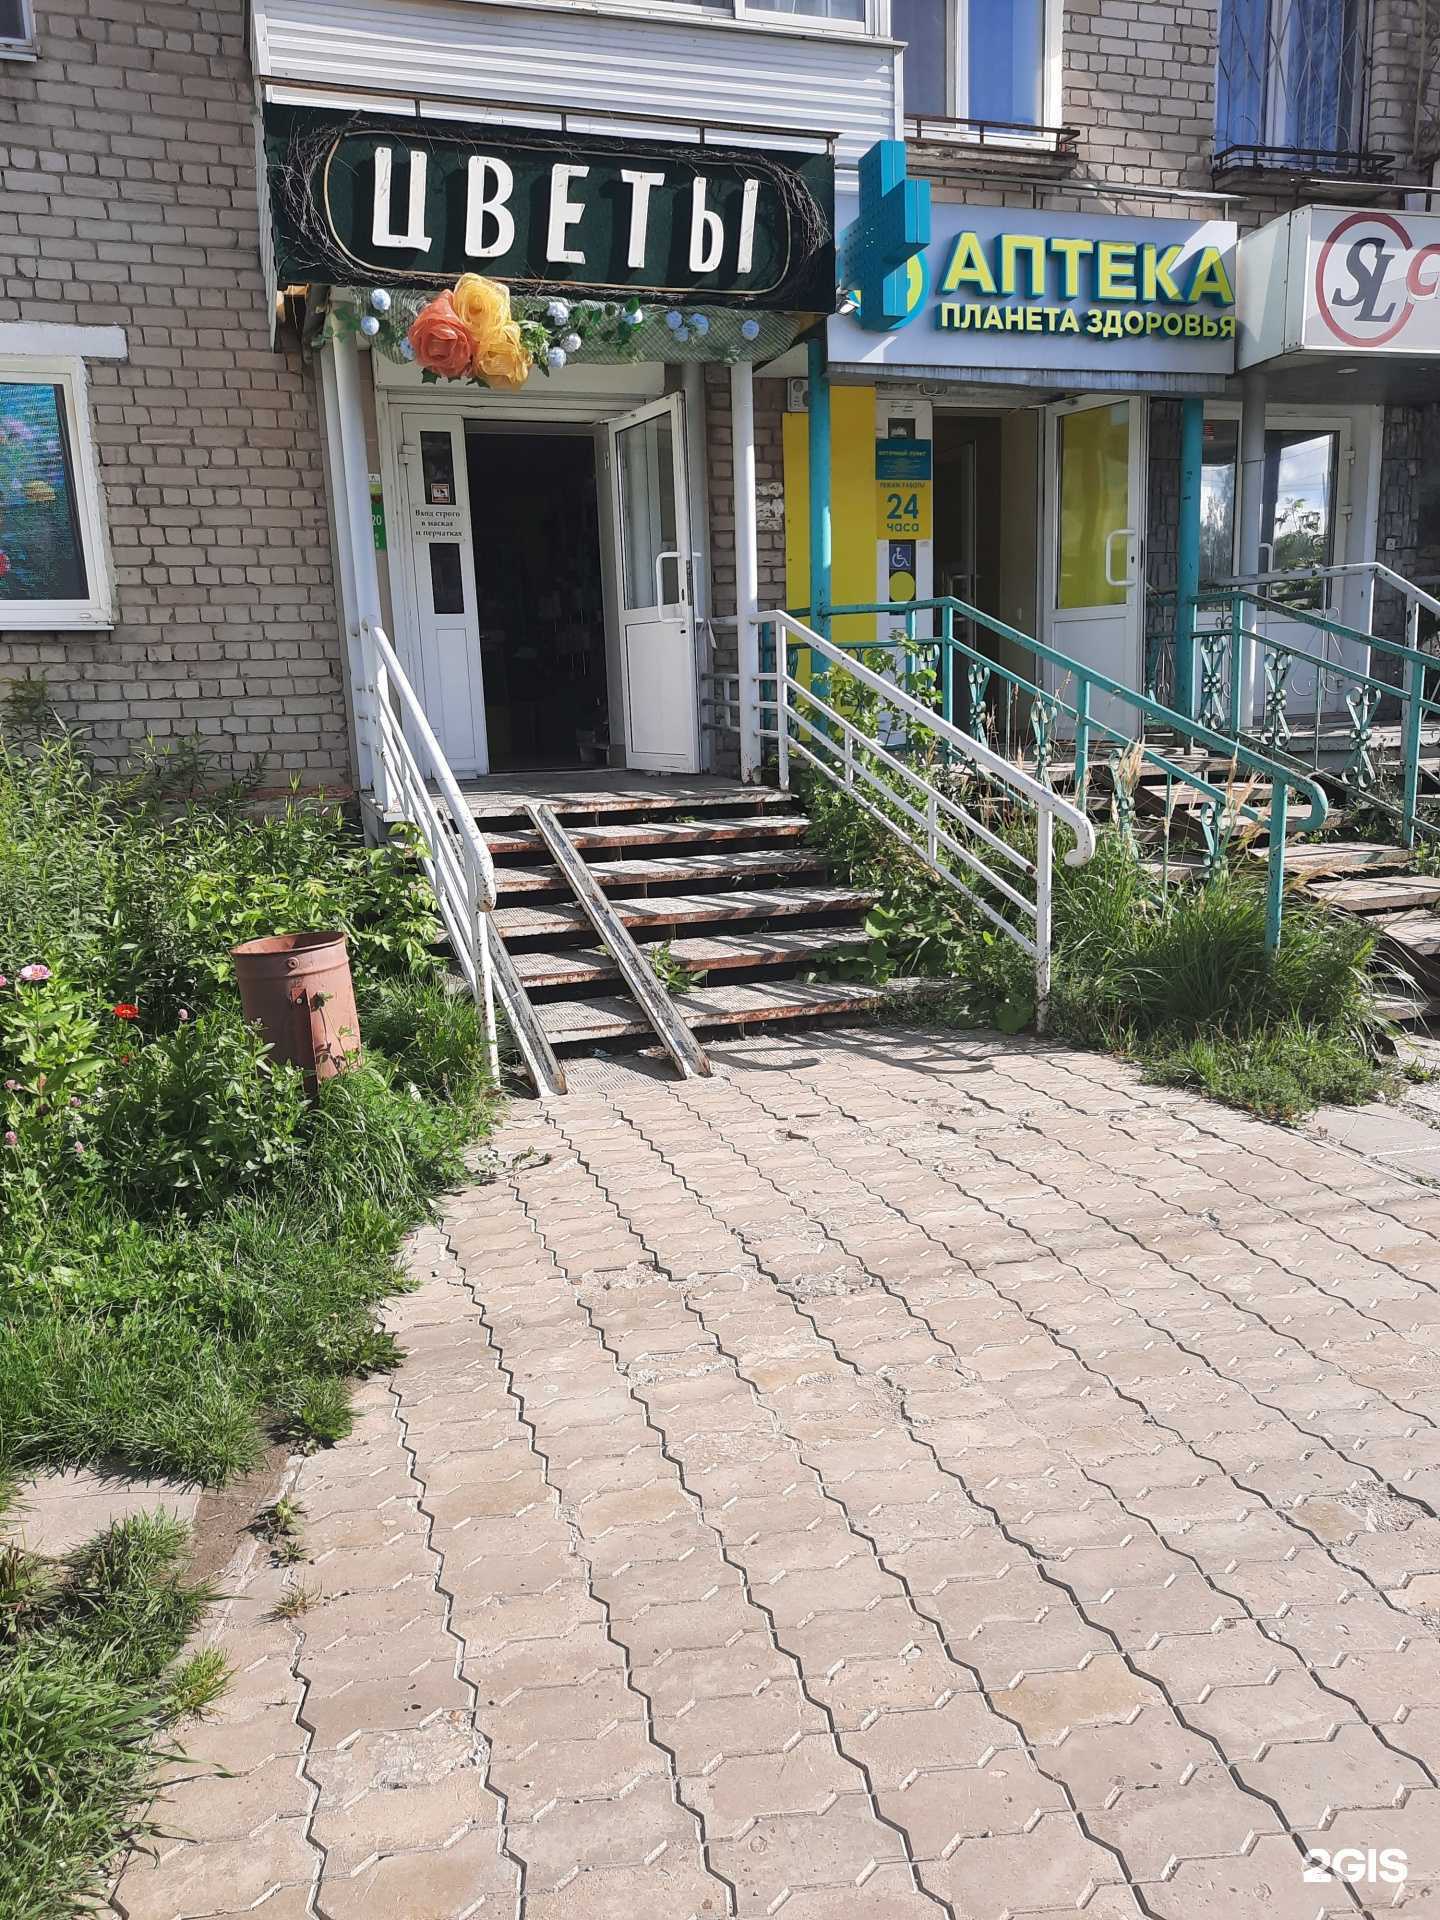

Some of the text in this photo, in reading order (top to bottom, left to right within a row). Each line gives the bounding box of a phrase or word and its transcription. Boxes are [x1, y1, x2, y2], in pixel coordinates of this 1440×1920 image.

[370, 146, 759, 274] ЦВЕТЫ
[940, 230, 1236, 306] АПТЕКА
[939, 301, 1237, 339] ПЛАНЕТА ЗДОРОВЬЯ
[415, 509, 461, 519] Вход строго
[886, 493, 920, 520] 24
[423, 530, 463, 539] перчатках
[886, 522, 920, 532] часа
